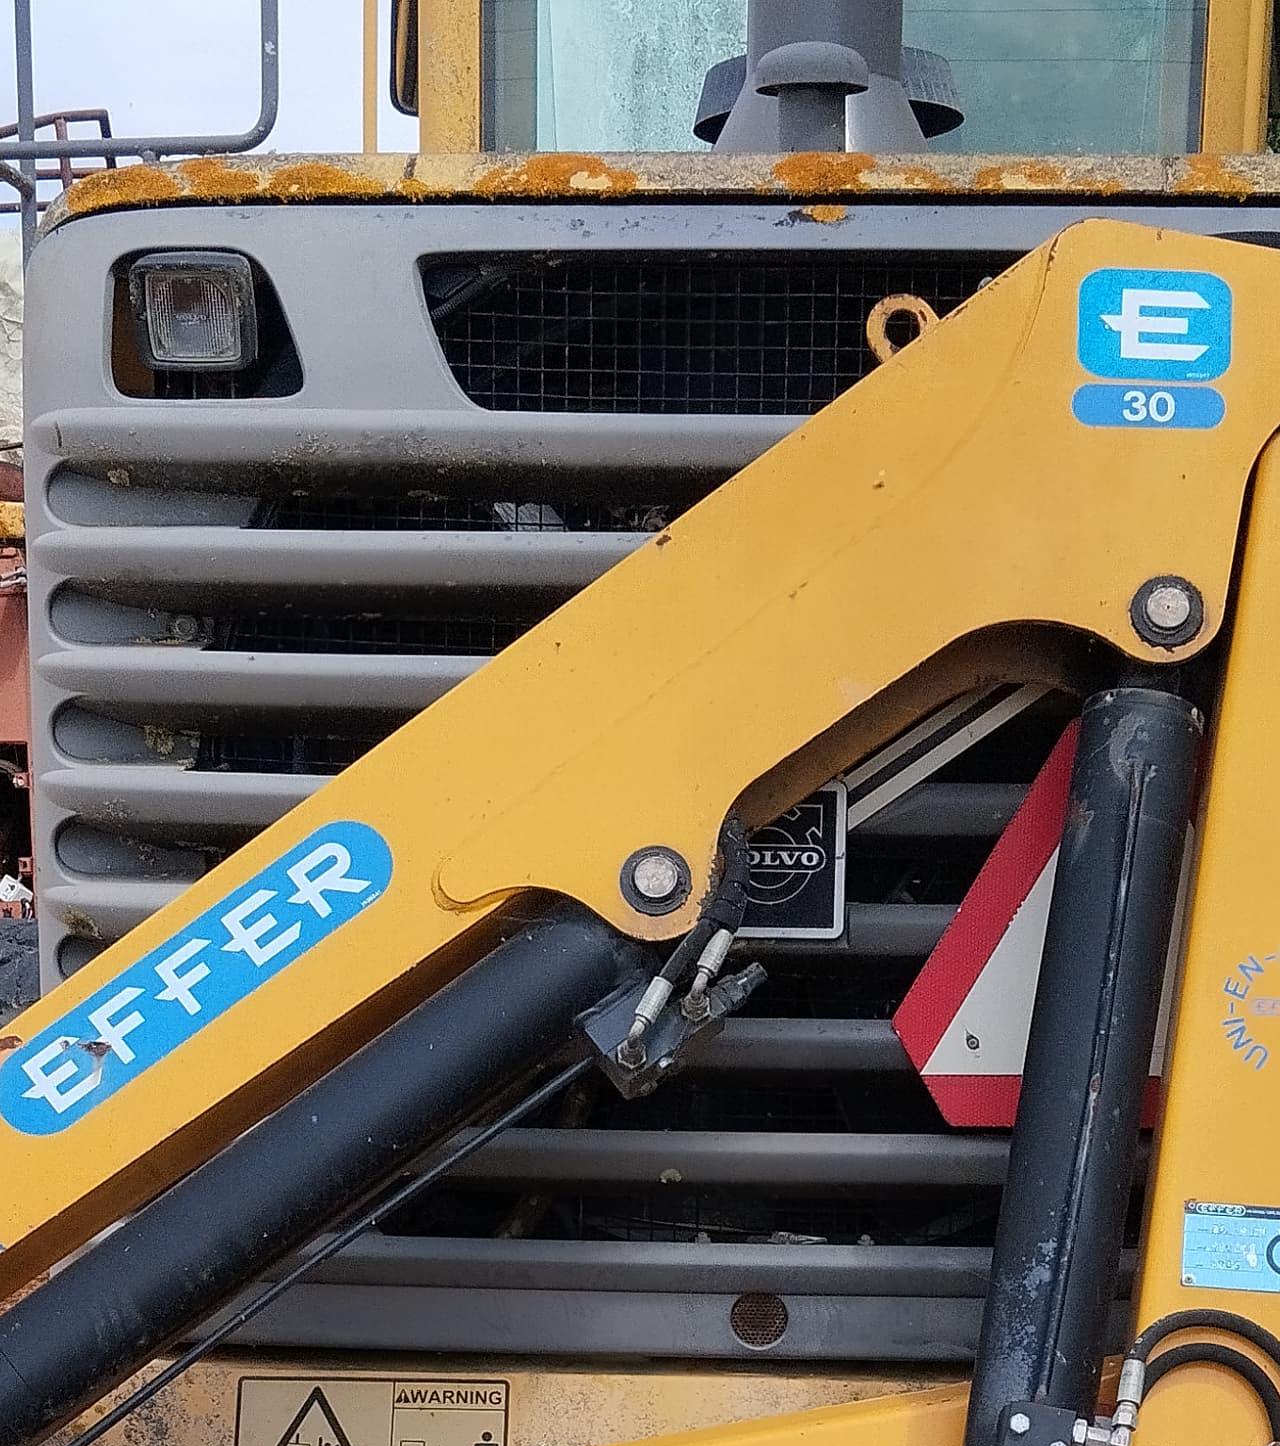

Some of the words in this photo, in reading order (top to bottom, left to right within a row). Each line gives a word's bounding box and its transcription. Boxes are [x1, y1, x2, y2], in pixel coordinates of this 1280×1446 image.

[1096, 285, 1212, 362] E
[1122, 391, 1176, 422] 30
[748, 851, 820, 866] OLVO
[20, 841, 373, 1115] EFFER
[409, 1389, 502, 1406] WARNING
